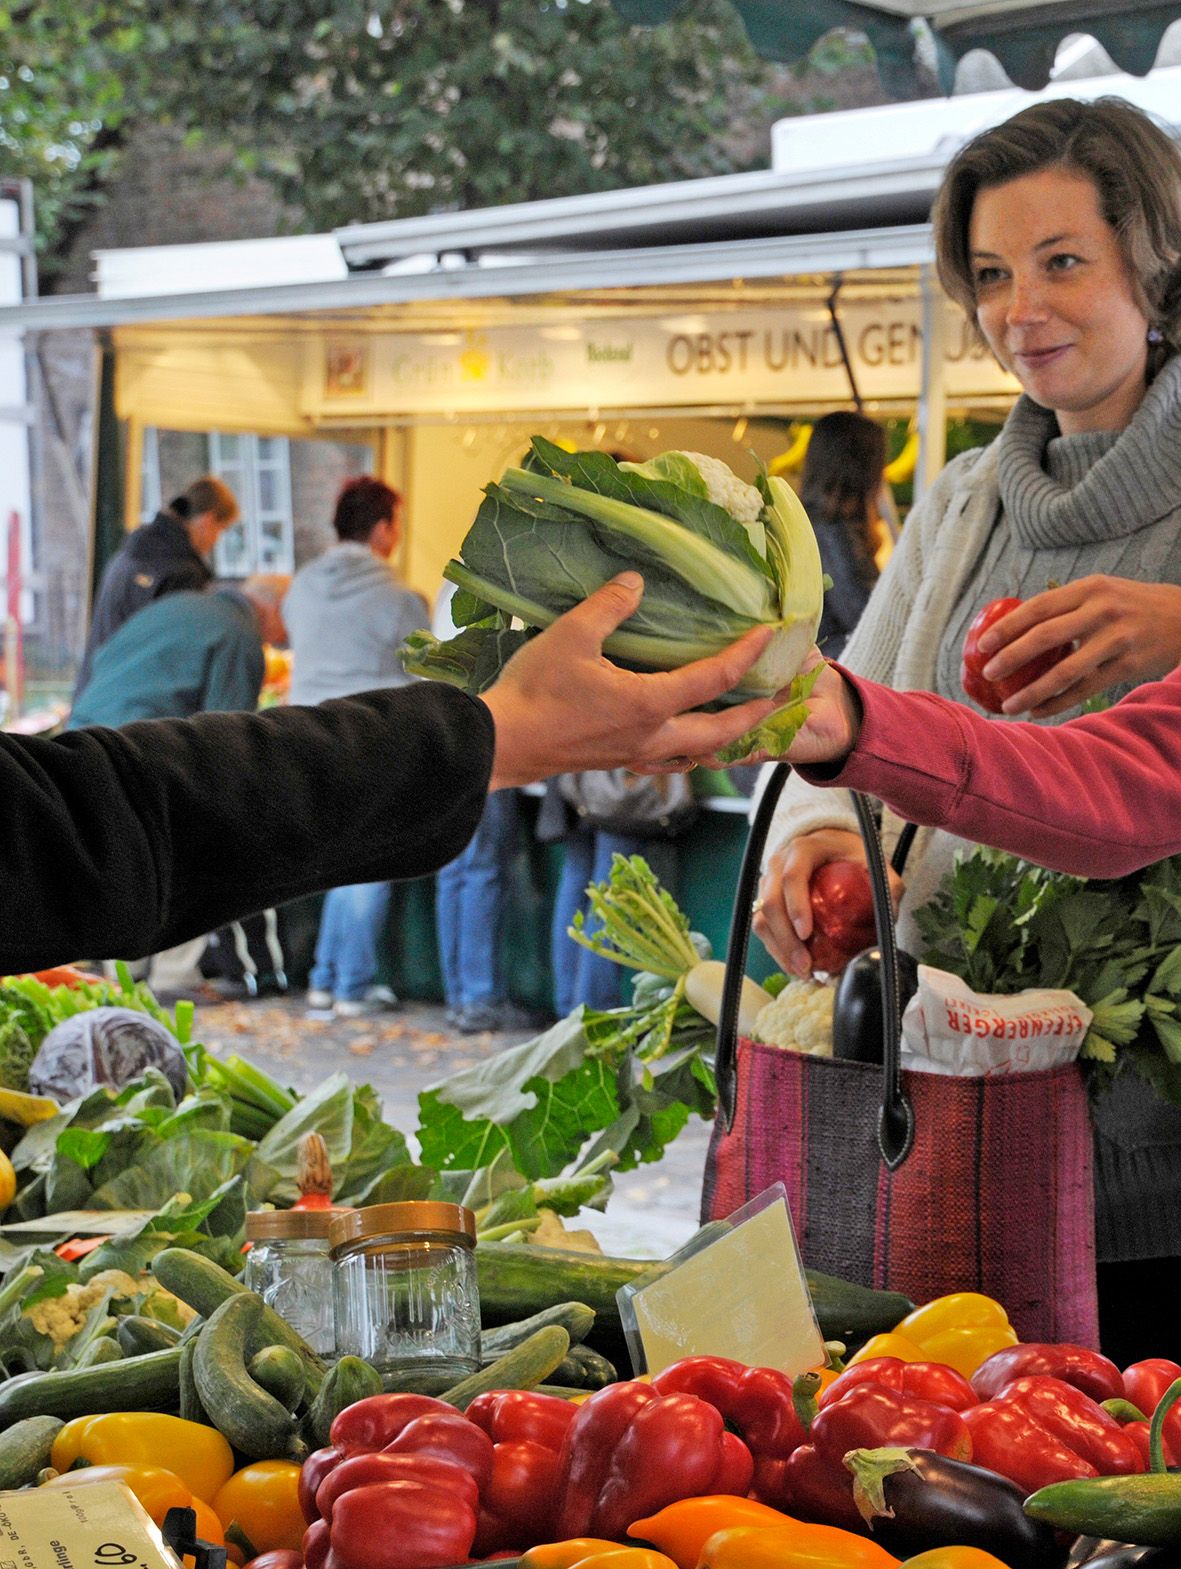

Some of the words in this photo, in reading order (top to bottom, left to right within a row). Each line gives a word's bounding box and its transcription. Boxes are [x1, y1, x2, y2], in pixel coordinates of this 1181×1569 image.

[665, 331, 754, 376] OBST
[763, 326, 847, 372] UND
[50, 1540, 75, 1569] rlinge
